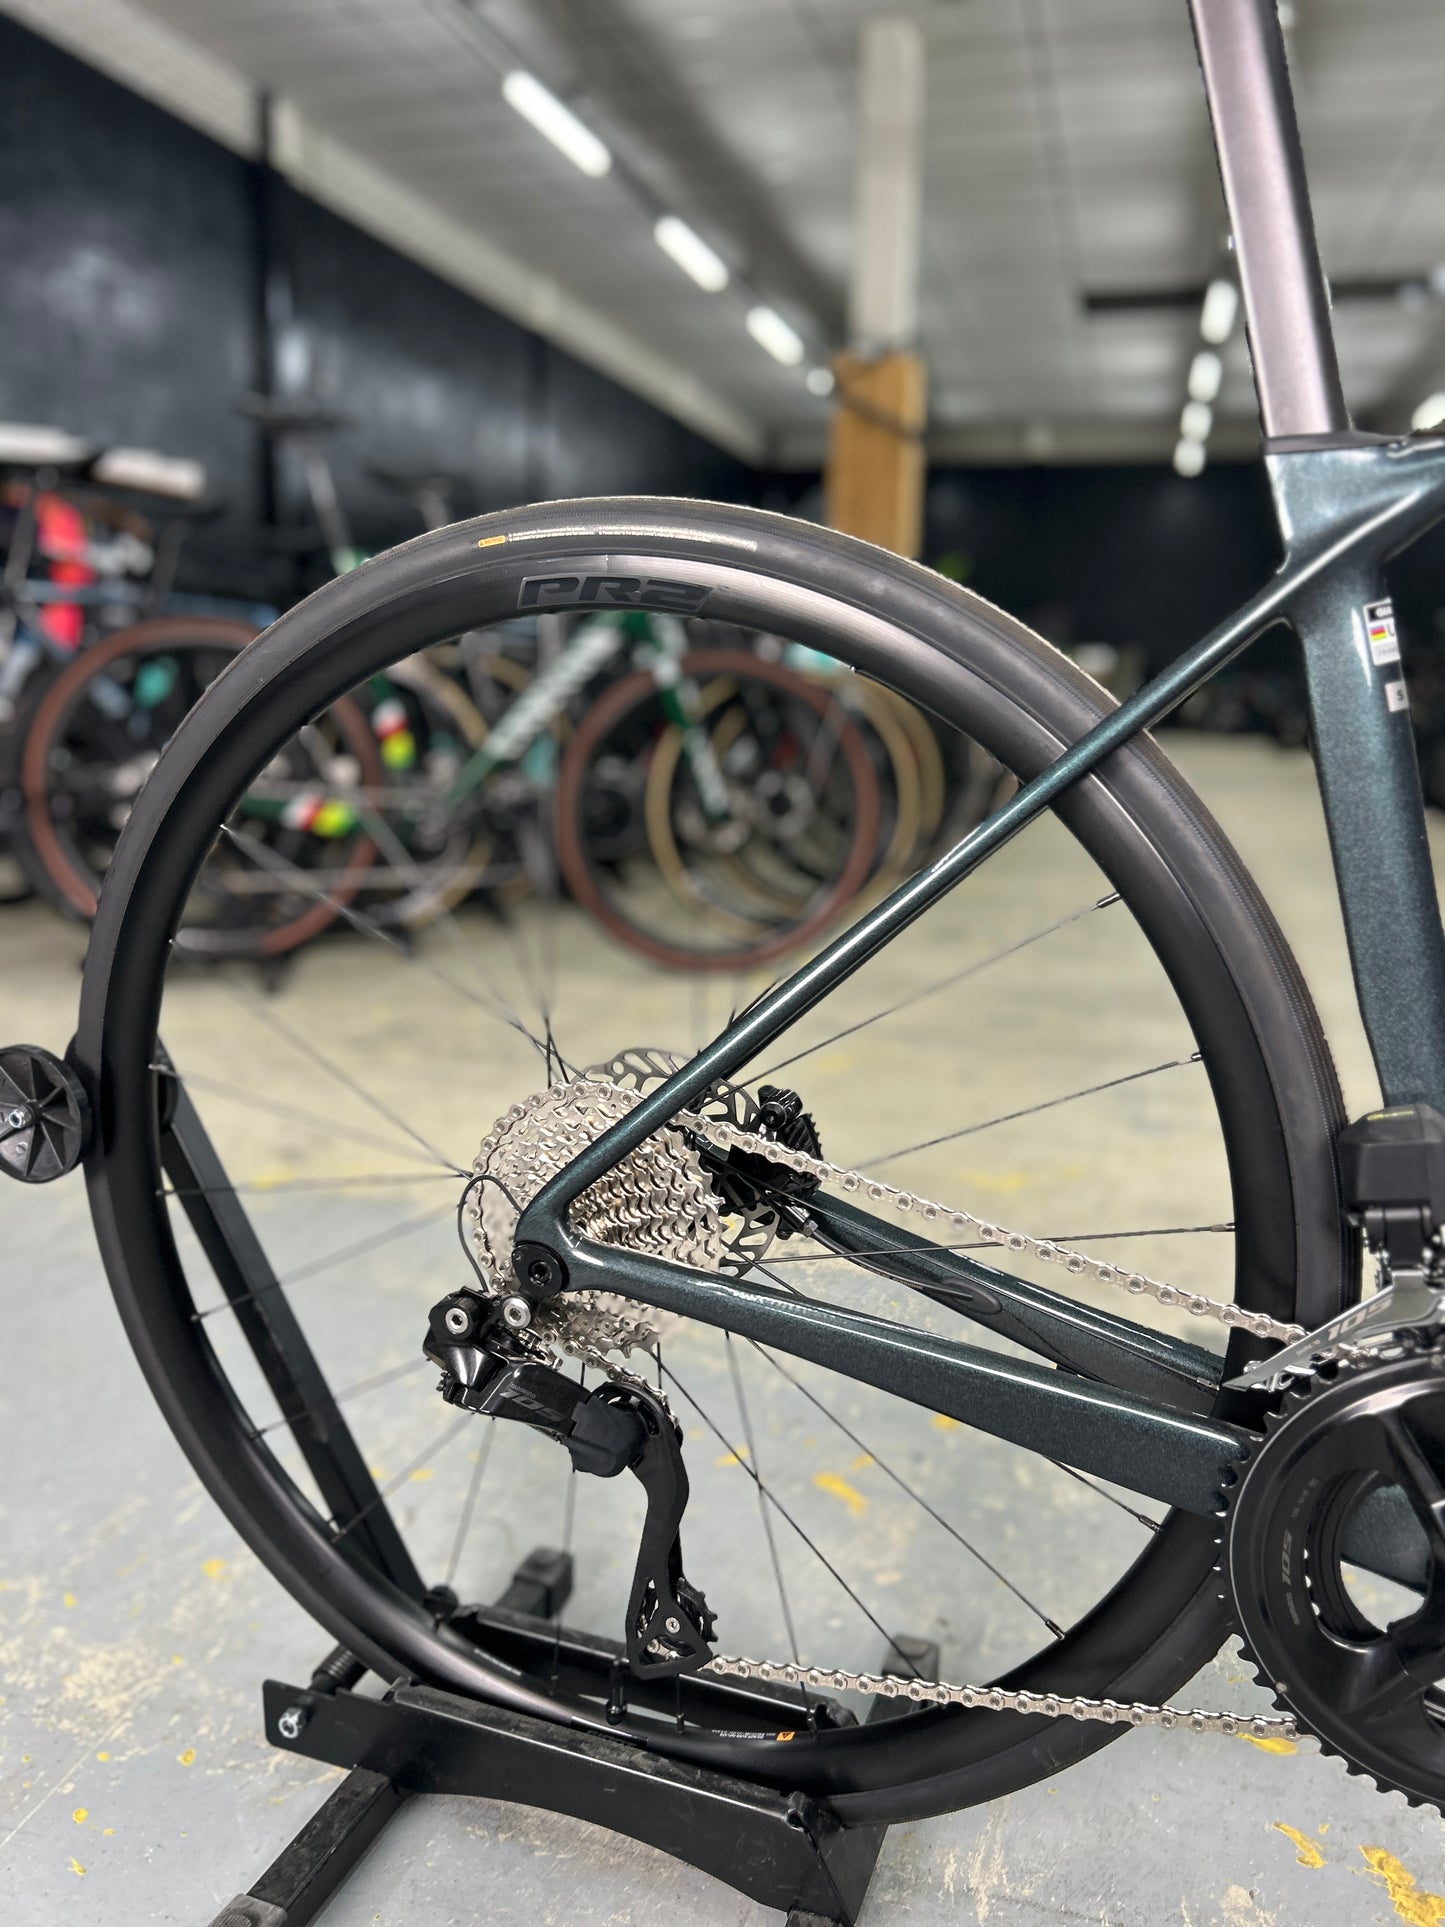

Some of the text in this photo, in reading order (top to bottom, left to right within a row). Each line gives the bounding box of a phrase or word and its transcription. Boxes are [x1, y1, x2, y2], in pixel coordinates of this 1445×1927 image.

[520, 575, 713, 612] PR2
[1327, 1293, 1394, 1341] 105
[1281, 1528, 1293, 1587] 105
